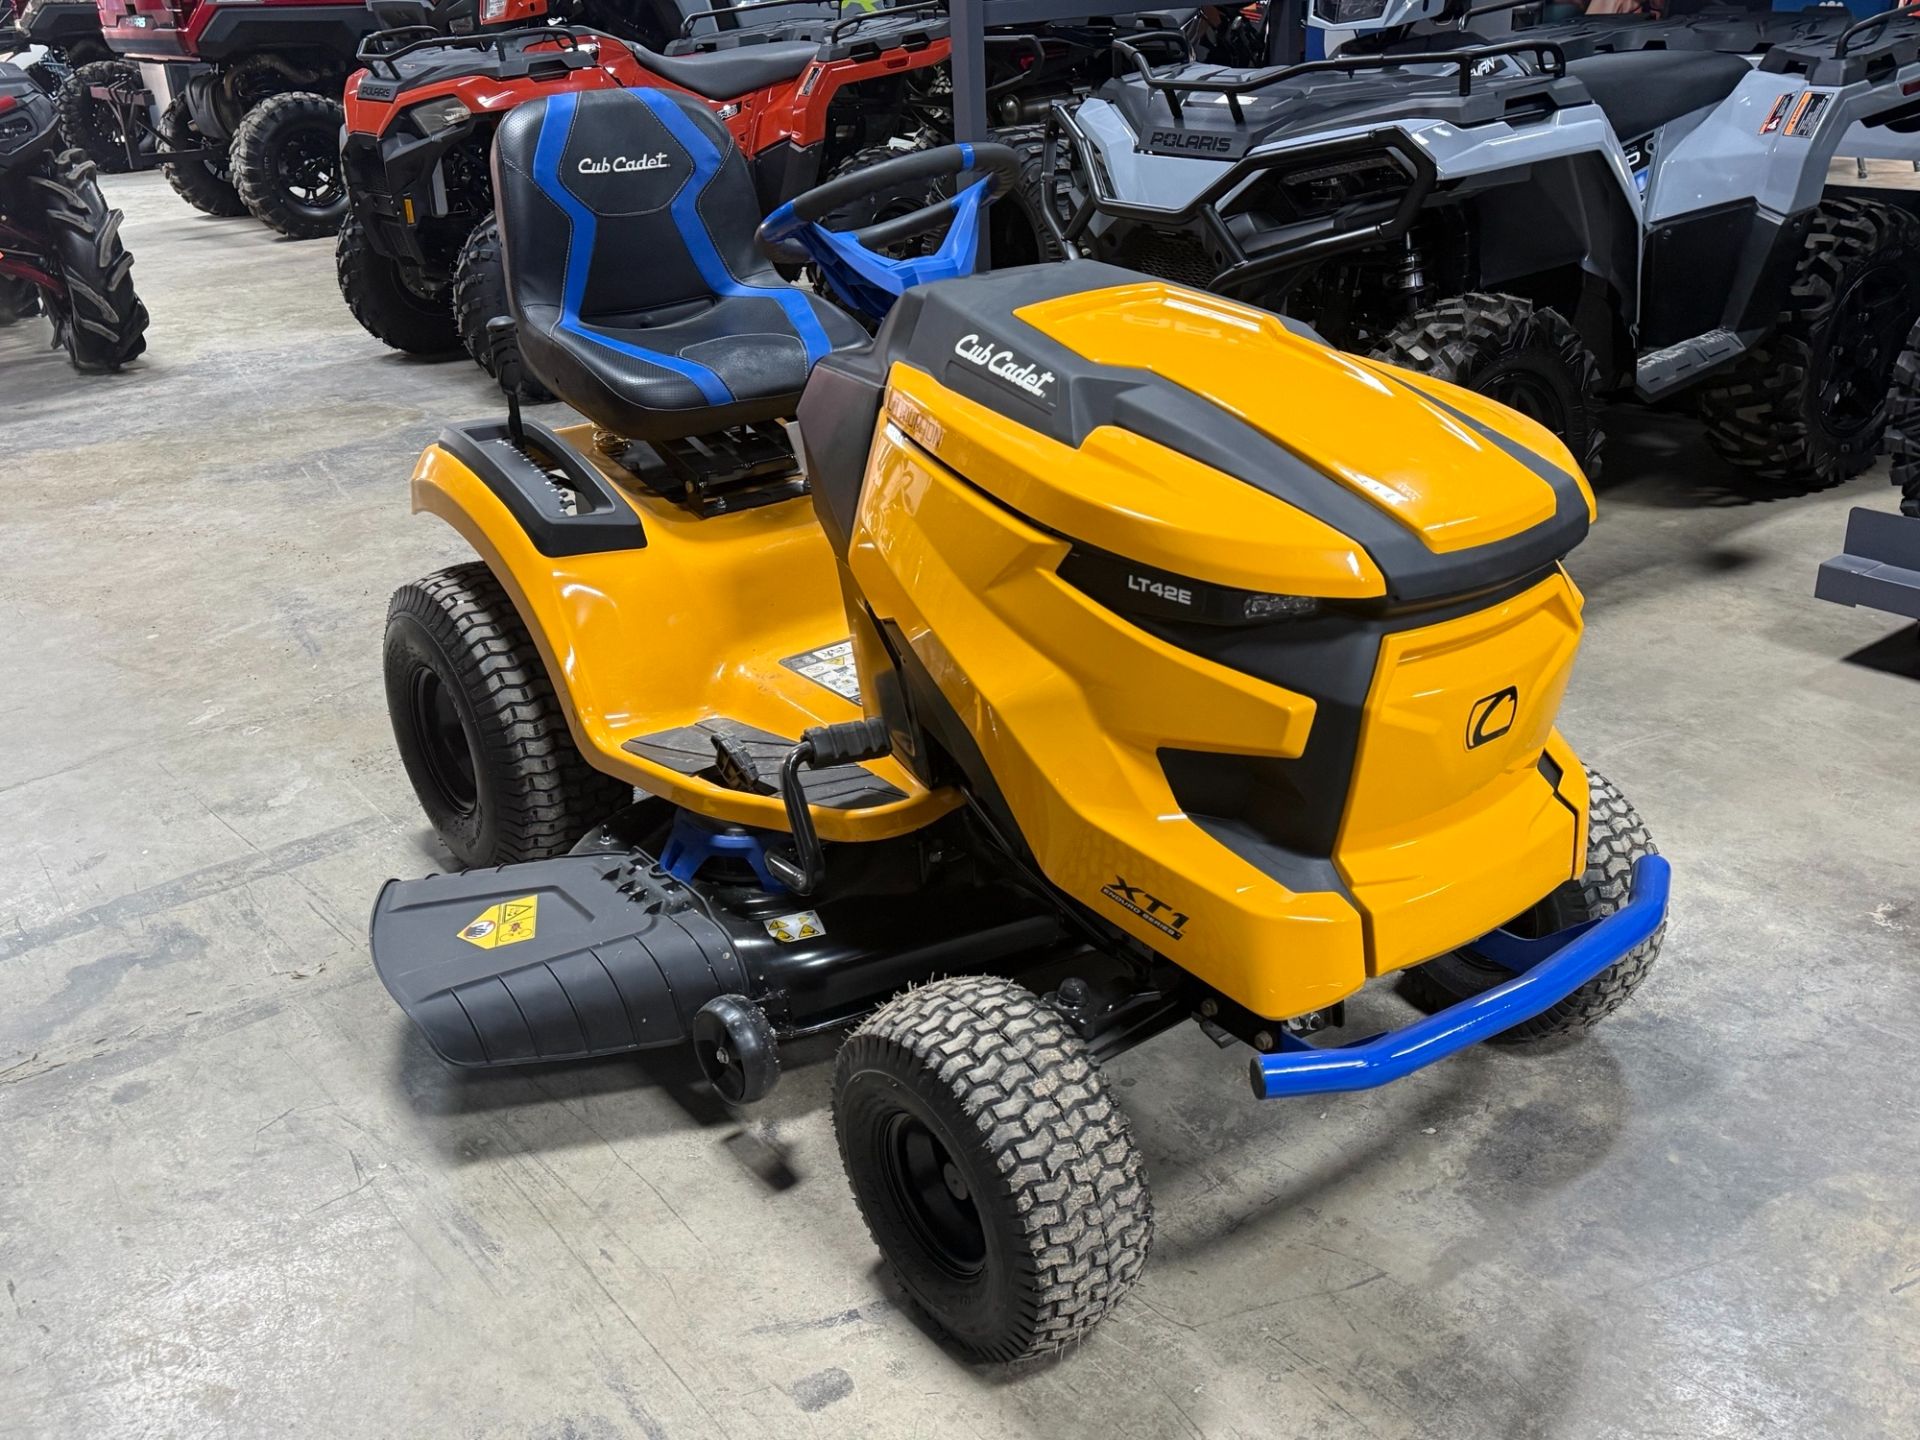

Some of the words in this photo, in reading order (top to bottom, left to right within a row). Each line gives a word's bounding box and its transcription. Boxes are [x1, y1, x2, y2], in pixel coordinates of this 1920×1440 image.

[362, 86, 391, 98] POLARIS
[1150, 131, 1232, 152] POLARIS
[578, 157, 611, 174] Cub
[613, 152, 668, 172] Cadet
[955, 334, 995, 365] Cub
[988, 351, 1055, 397] Cadet
[1128, 574, 1192, 606] LT42E
[1105, 874, 1190, 929] XT1
